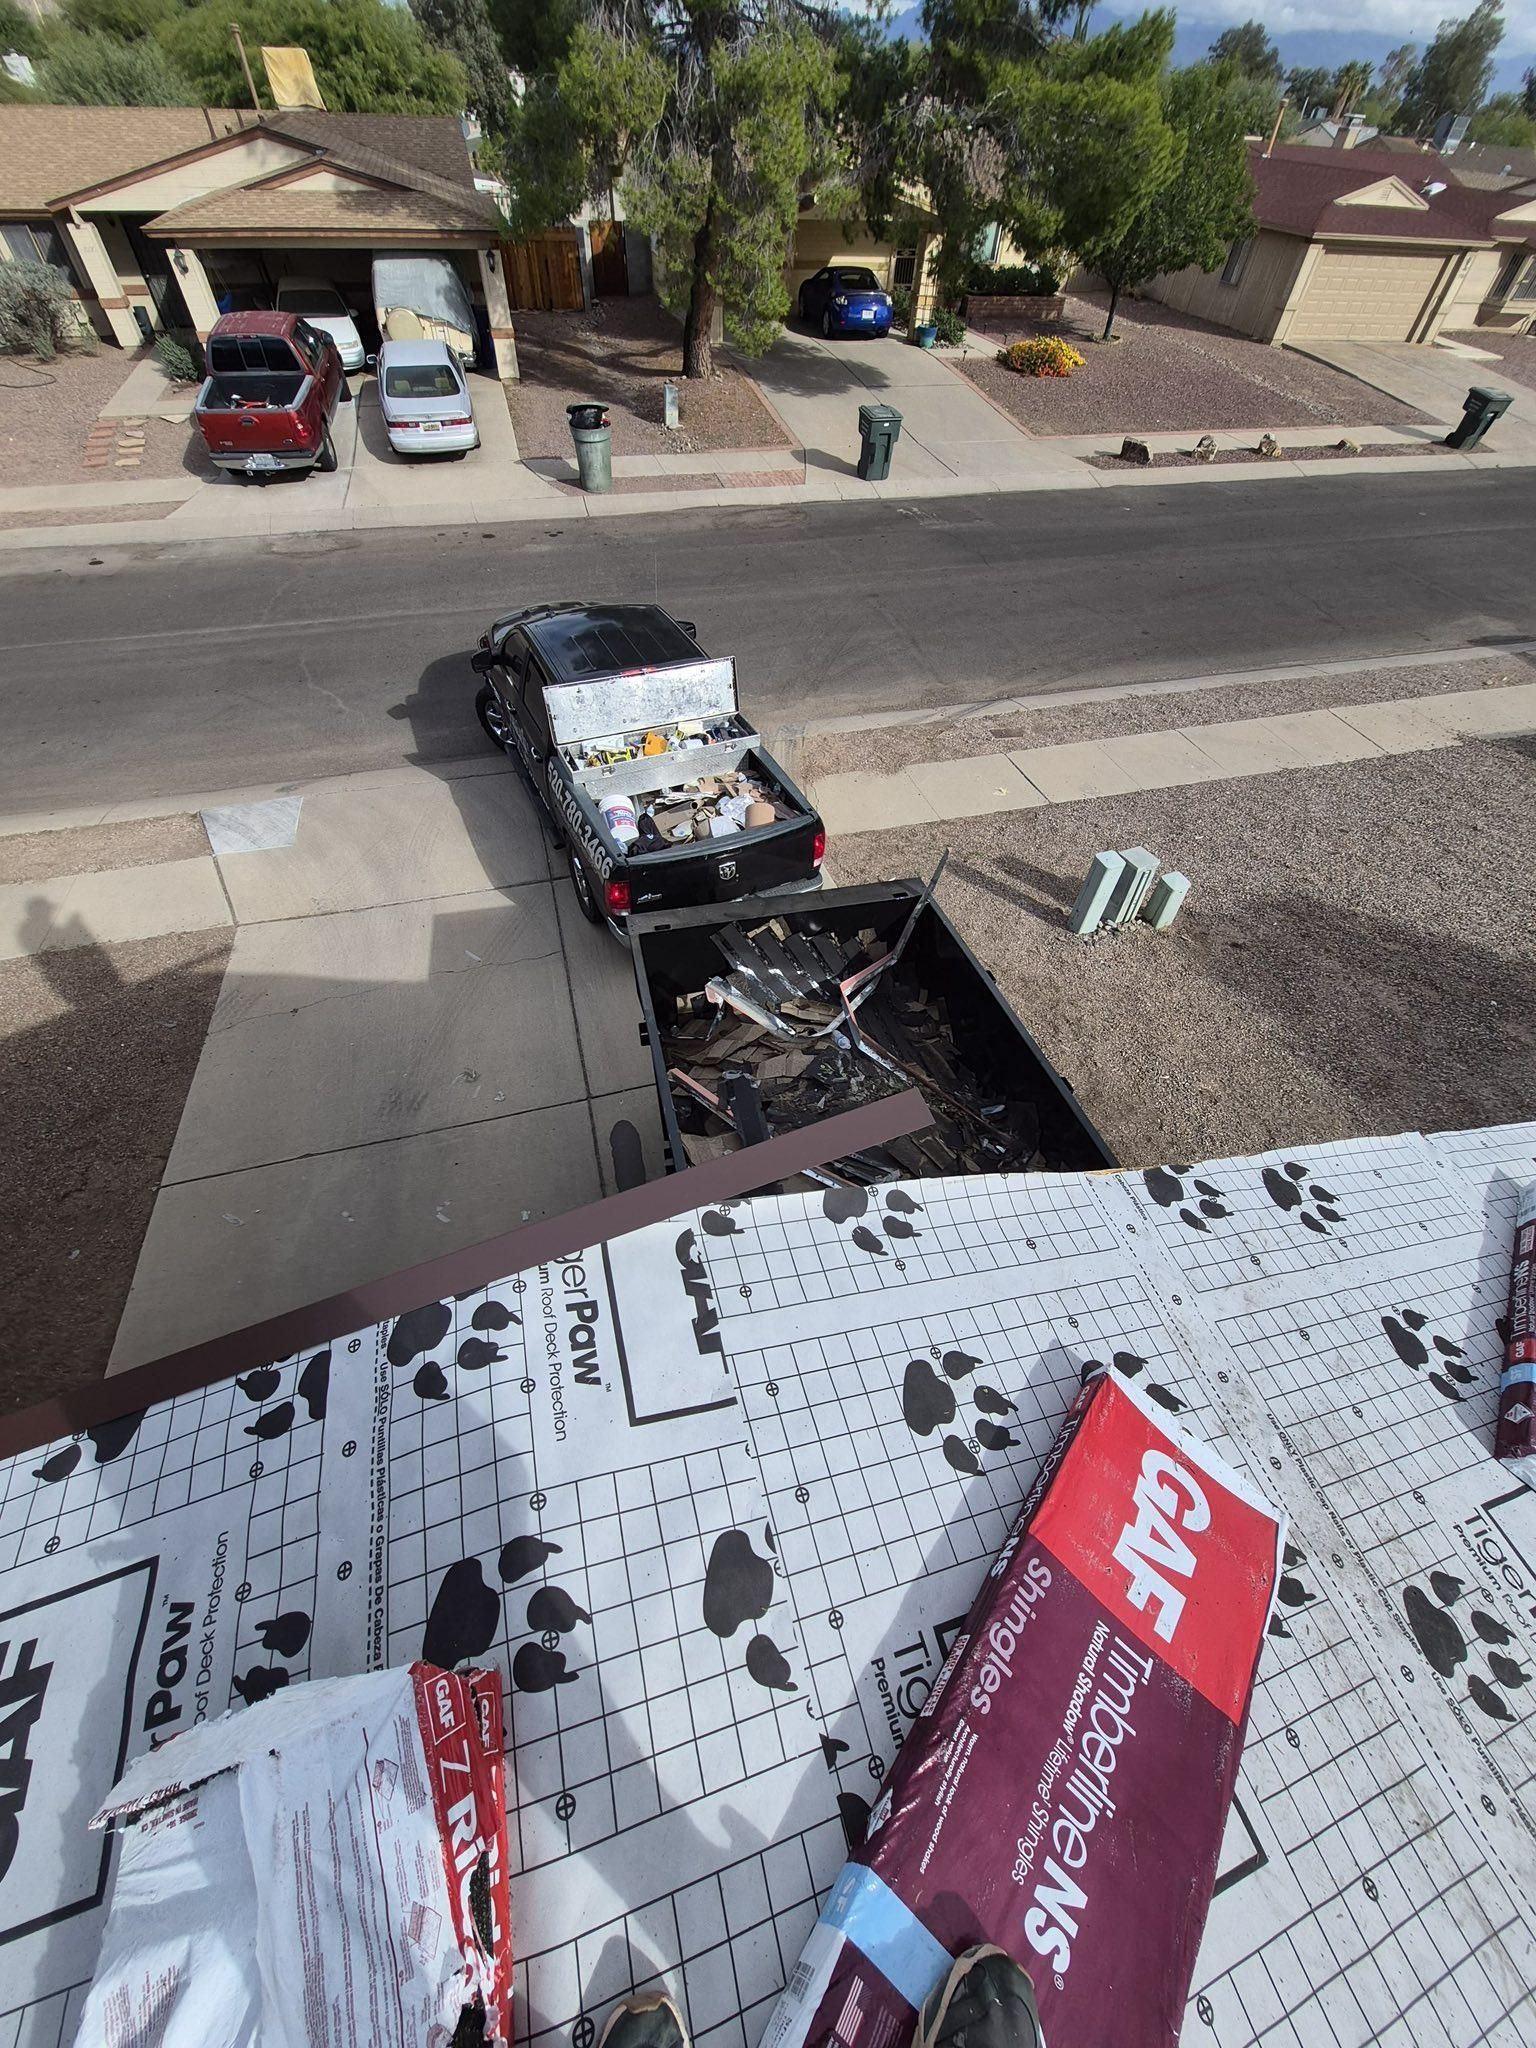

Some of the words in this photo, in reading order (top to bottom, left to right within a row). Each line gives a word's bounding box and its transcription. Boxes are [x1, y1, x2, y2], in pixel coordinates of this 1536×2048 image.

[541, 1288, 556, 1318] Roof
[544, 1323, 558, 1360] Deck
[1515, 1342, 1525, 1358] GAF
[380, 1362, 388, 1383] Use
[379, 1384, 390, 1416] SÓLO
[548, 1362, 567, 1442] Protection
[377, 1417, 387, 1466] Puntillas
[376, 1468, 386, 1521] Plásticas
[991, 1415, 1080, 1578] TimberlineNS
[376, 1525, 384, 1533] o
[1112, 1448, 1212, 1643] GAF
[203, 1530, 229, 1627] Protection
[374, 1535, 385, 1584] Grapas
[1453, 1525, 1502, 1591] Premium
[1502, 1593, 1532, 1629] Roof
[374, 1586, 384, 1605] De
[1266, 1413, 1280, 1430] Use
[1279, 1431, 1298, 1457] ONLY
[1295, 1458, 1316, 1489] Plastic
[1315, 1490, 1329, 1510] Cap
[1328, 1511, 1346, 1537] Nails
[1345, 1538, 1356, 1551] or
[1353, 1551, 1379, 1587] Plastic
[1378, 1588, 1393, 1612] Cap
[1392, 1612, 1422, 1655] Staples
[1431, 1671, 1447, 1695] Use
[1471, 1736, 1510, 1796] Puntillas
[196, 1629, 214, 1681] Deck
[373, 1609, 384, 1661] Cabeza
[971, 1557, 1052, 1715] Shingles
[1084, 1619, 1110, 1677] Natural
[435, 1679, 455, 1728] GAF
[481, 1699, 490, 1748] GAF
[944, 1725, 970, 1781] Architecturally
[953, 1757, 969, 1788] natural
[935, 1779, 948, 1807] stylish
[942, 1806, 948, 1818] of
[945, 1785, 957, 1805] look
[932, 1816, 945, 1843] wood
[1012, 1801, 1050, 1885] Shingles
[919, 1842, 936, 1874] shakes
